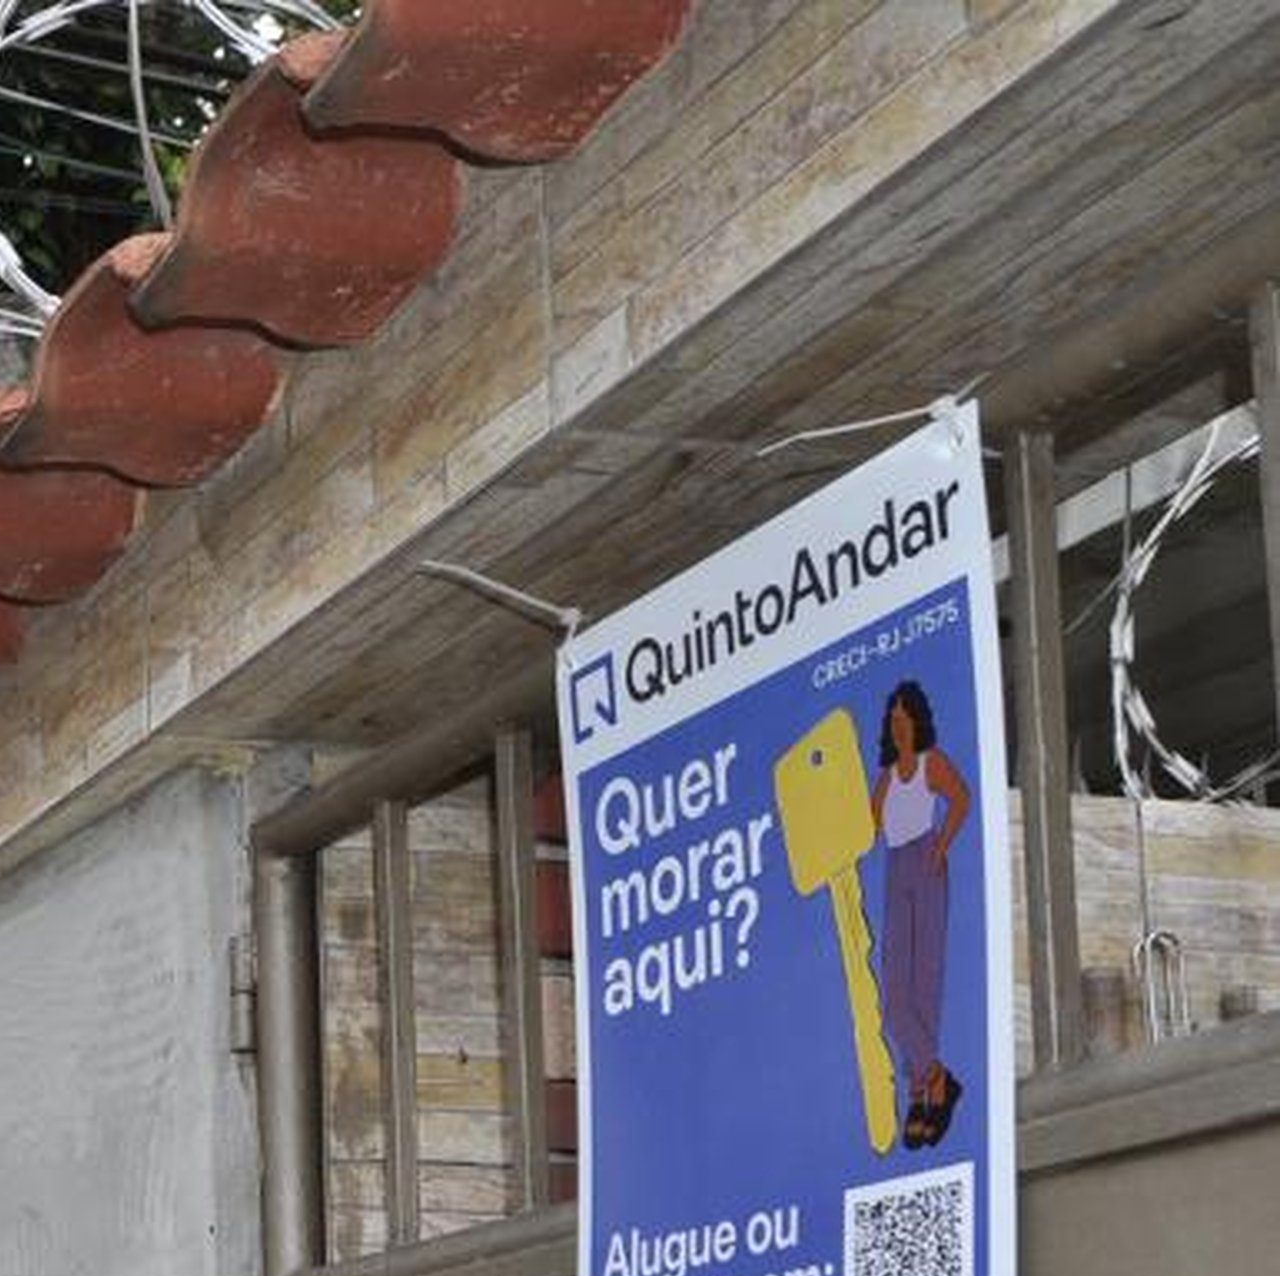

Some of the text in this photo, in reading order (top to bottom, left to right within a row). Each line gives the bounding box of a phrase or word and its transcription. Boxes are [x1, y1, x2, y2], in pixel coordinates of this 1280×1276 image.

[624, 479, 961, 702] QuintoAndar
[595, 743, 737, 855] Quer
[601, 813, 773, 938] morar
[604, 886, 760, 1016] aqui?
[746, 1204, 800, 1255] ou
